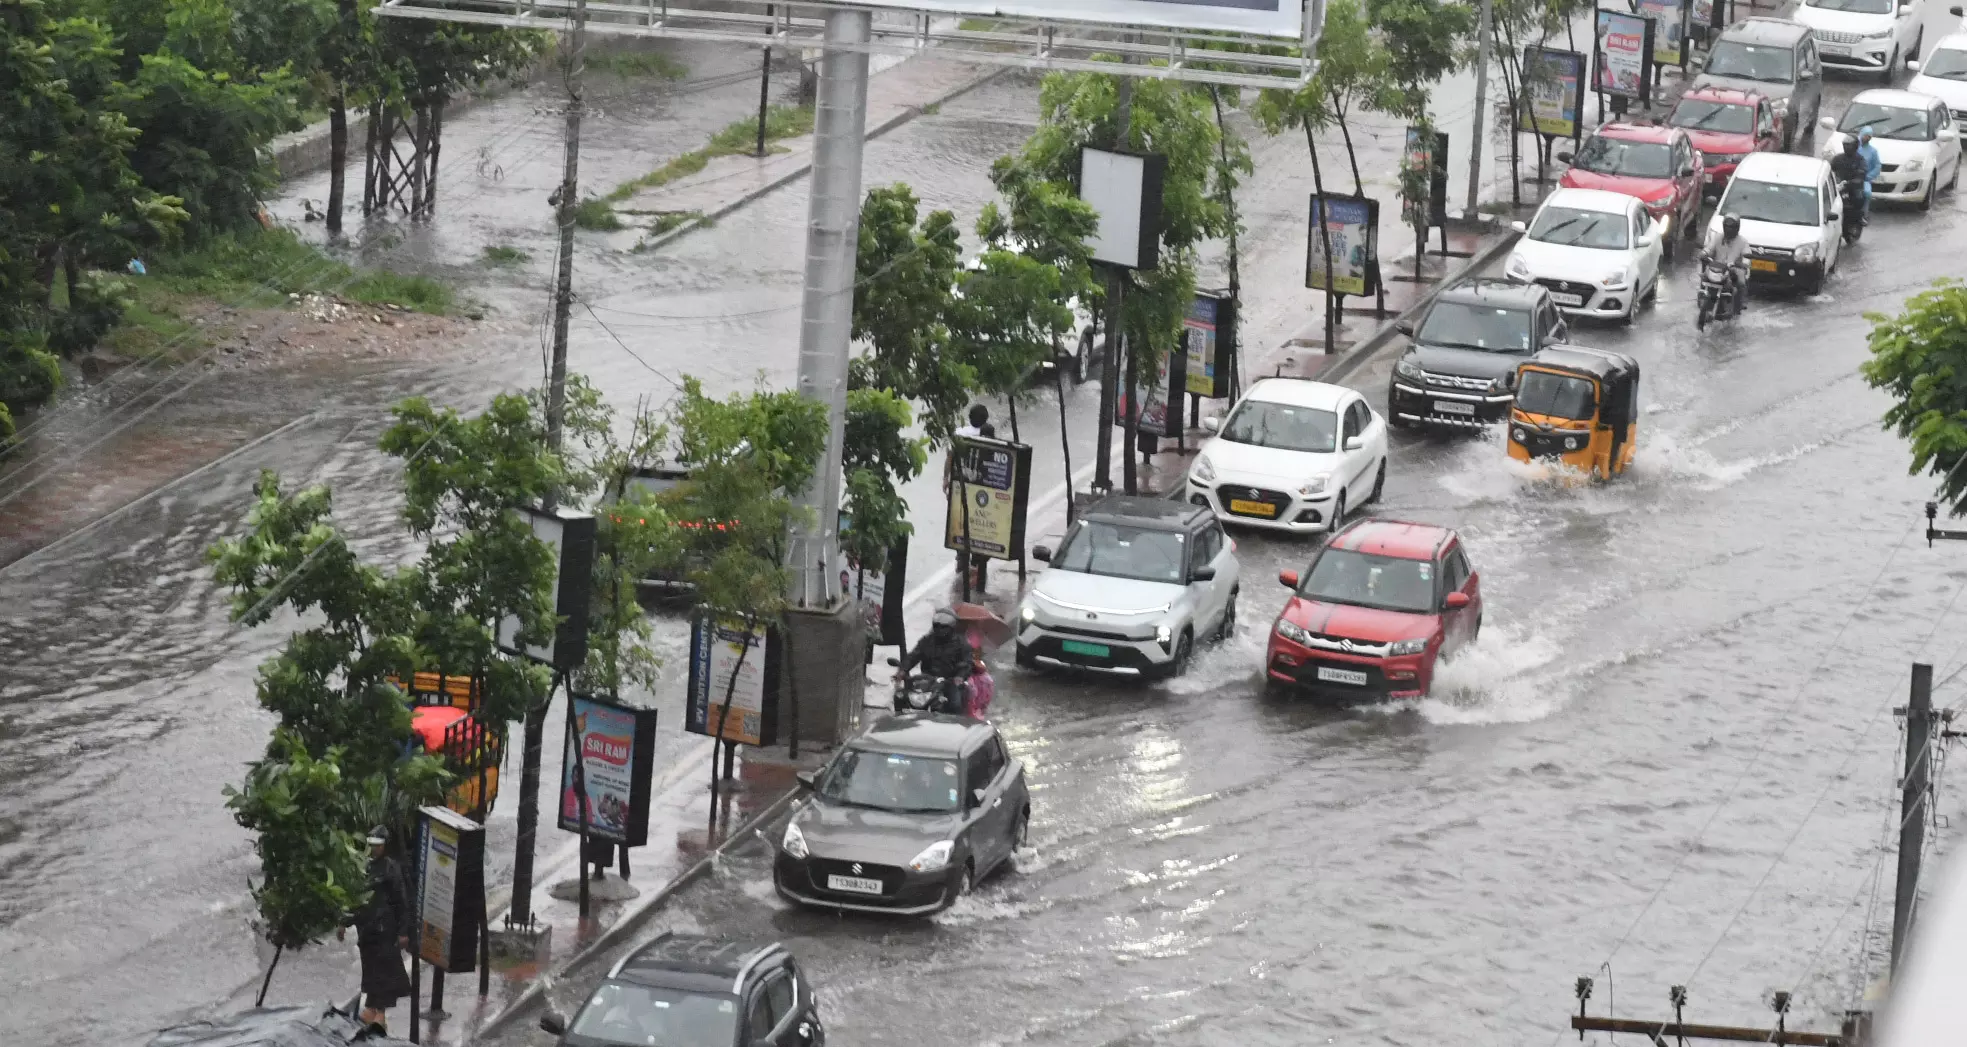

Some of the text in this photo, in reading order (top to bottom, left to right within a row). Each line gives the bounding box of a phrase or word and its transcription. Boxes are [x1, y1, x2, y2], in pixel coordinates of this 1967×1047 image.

[993, 452, 1008, 464] NO
[696, 661, 707, 705] TUITION
[586, 737, 628, 760] SRI RAM
